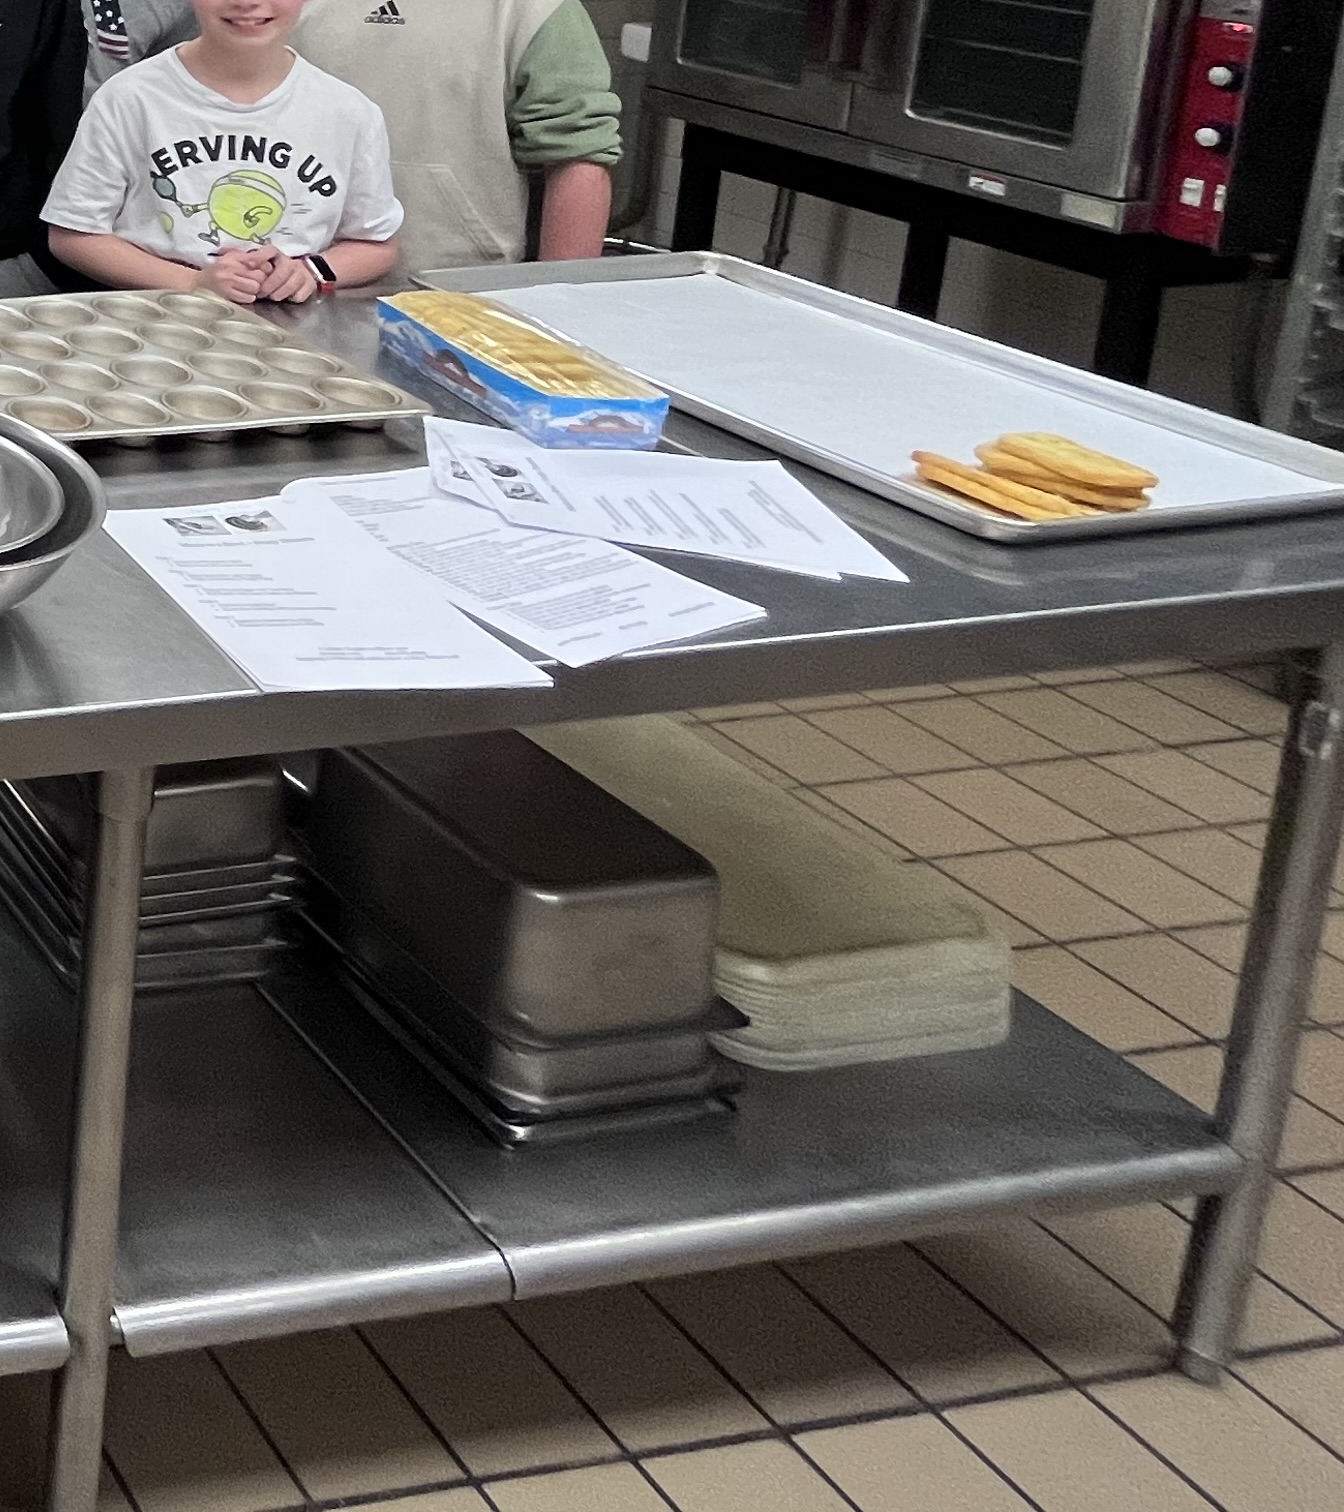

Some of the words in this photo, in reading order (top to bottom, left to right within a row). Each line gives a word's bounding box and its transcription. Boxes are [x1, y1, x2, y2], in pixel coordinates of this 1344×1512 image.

[364, 15, 406, 25] adidas
[150, 135, 292, 179] ERVING
[297, 155, 337, 197] UP
